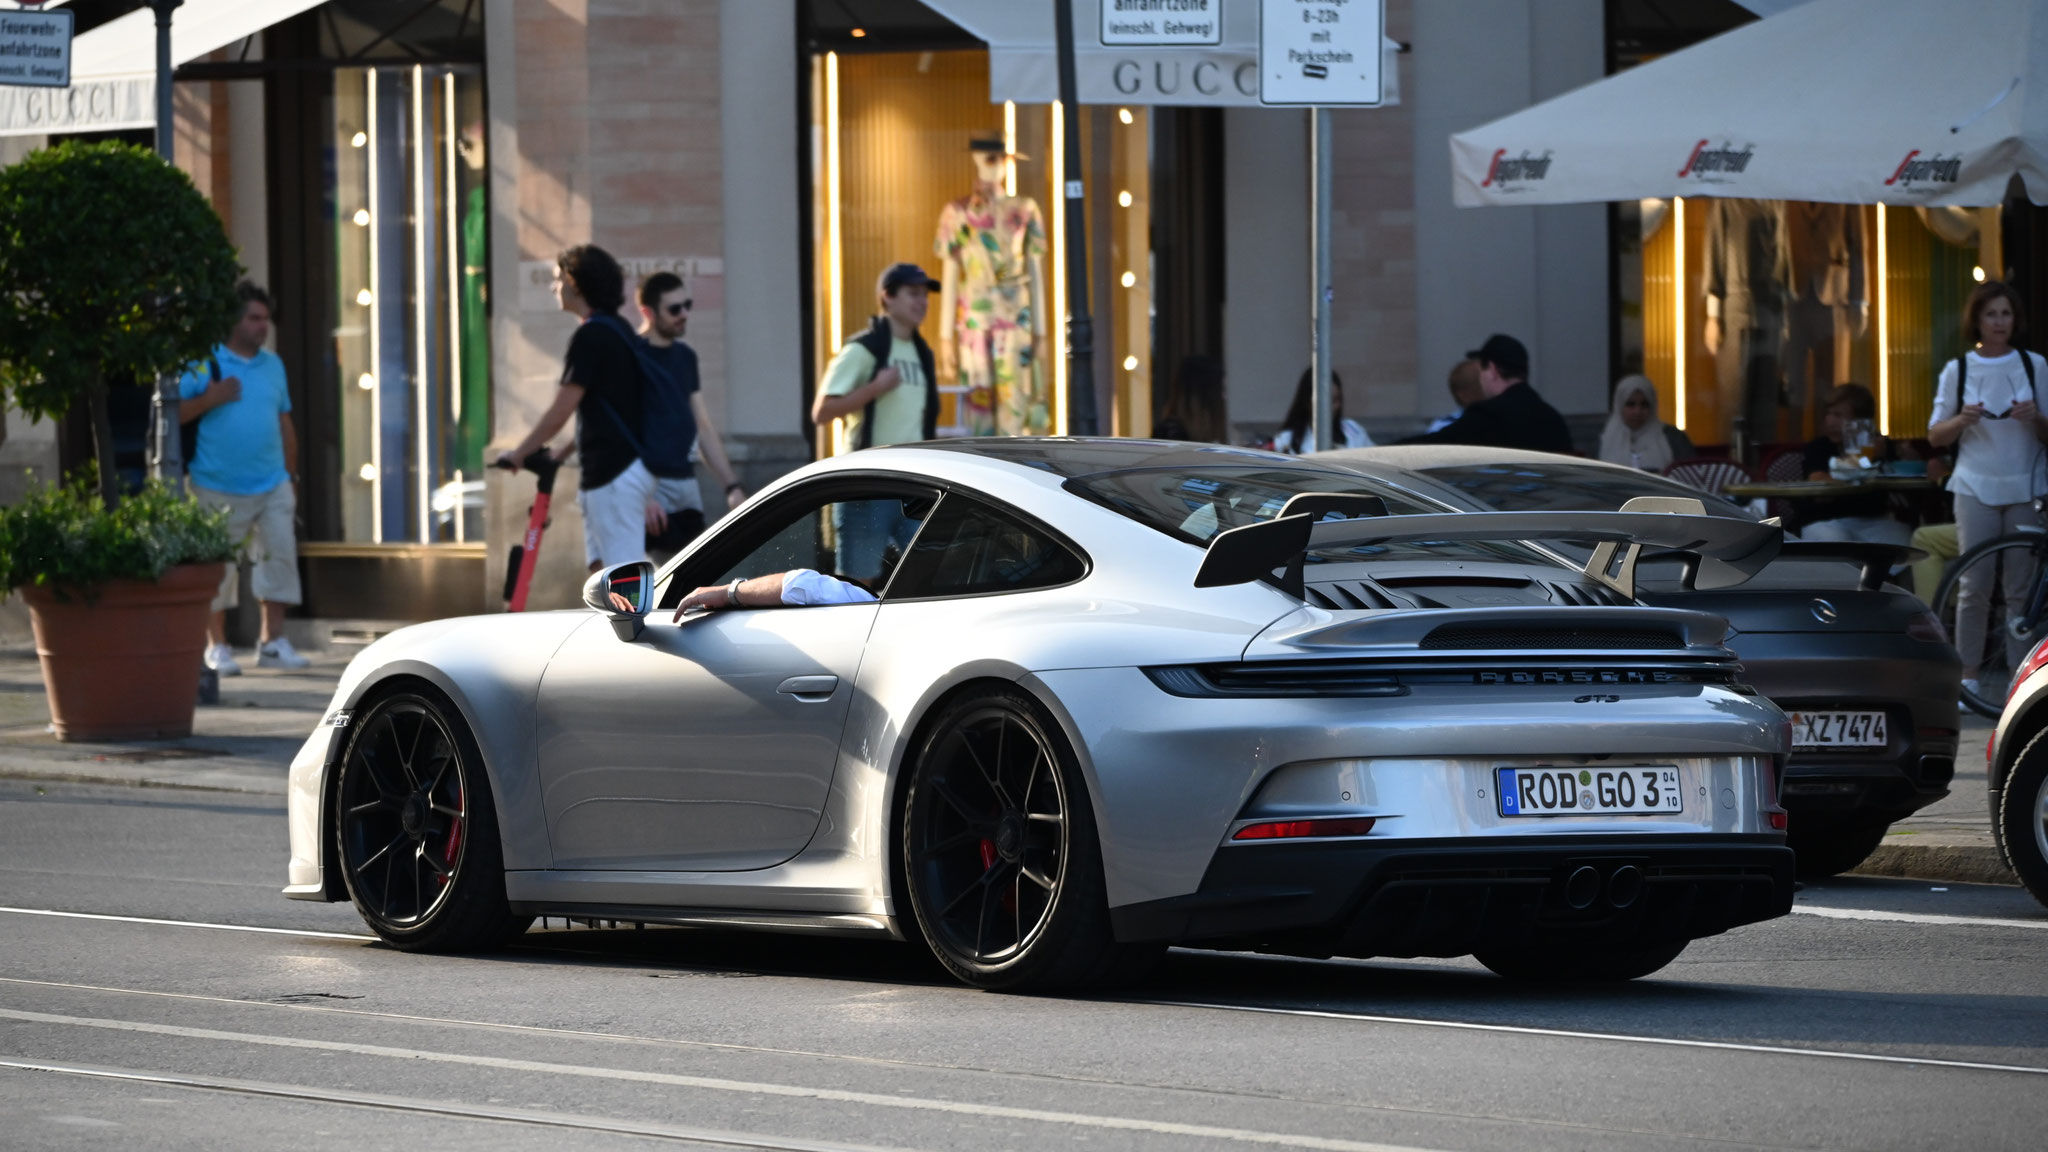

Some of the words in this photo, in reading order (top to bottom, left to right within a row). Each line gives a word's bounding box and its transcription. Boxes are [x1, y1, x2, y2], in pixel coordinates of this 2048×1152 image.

[1311, 30, 1331, 43] mit
[1288, 48, 1353, 63] Parkschein
[1113, 60, 1258, 95] GUCC
[27, 84, 117, 124] GUCCI
[1480, 671, 1668, 683] PORSCHE
[1573, 694, 1621, 704] GT3
[1804, 714, 1833, 743] XZ
[1836, 714, 1885, 743] 7474
[1506, 796, 1514, 807] D
[1518, 772, 1578, 809] ROD
[1597, 771, 1636, 808] GO
[1642, 772, 1660, 808] 3
[1663, 772, 1676, 783] 04
[1666, 796, 1678, 807] 10
